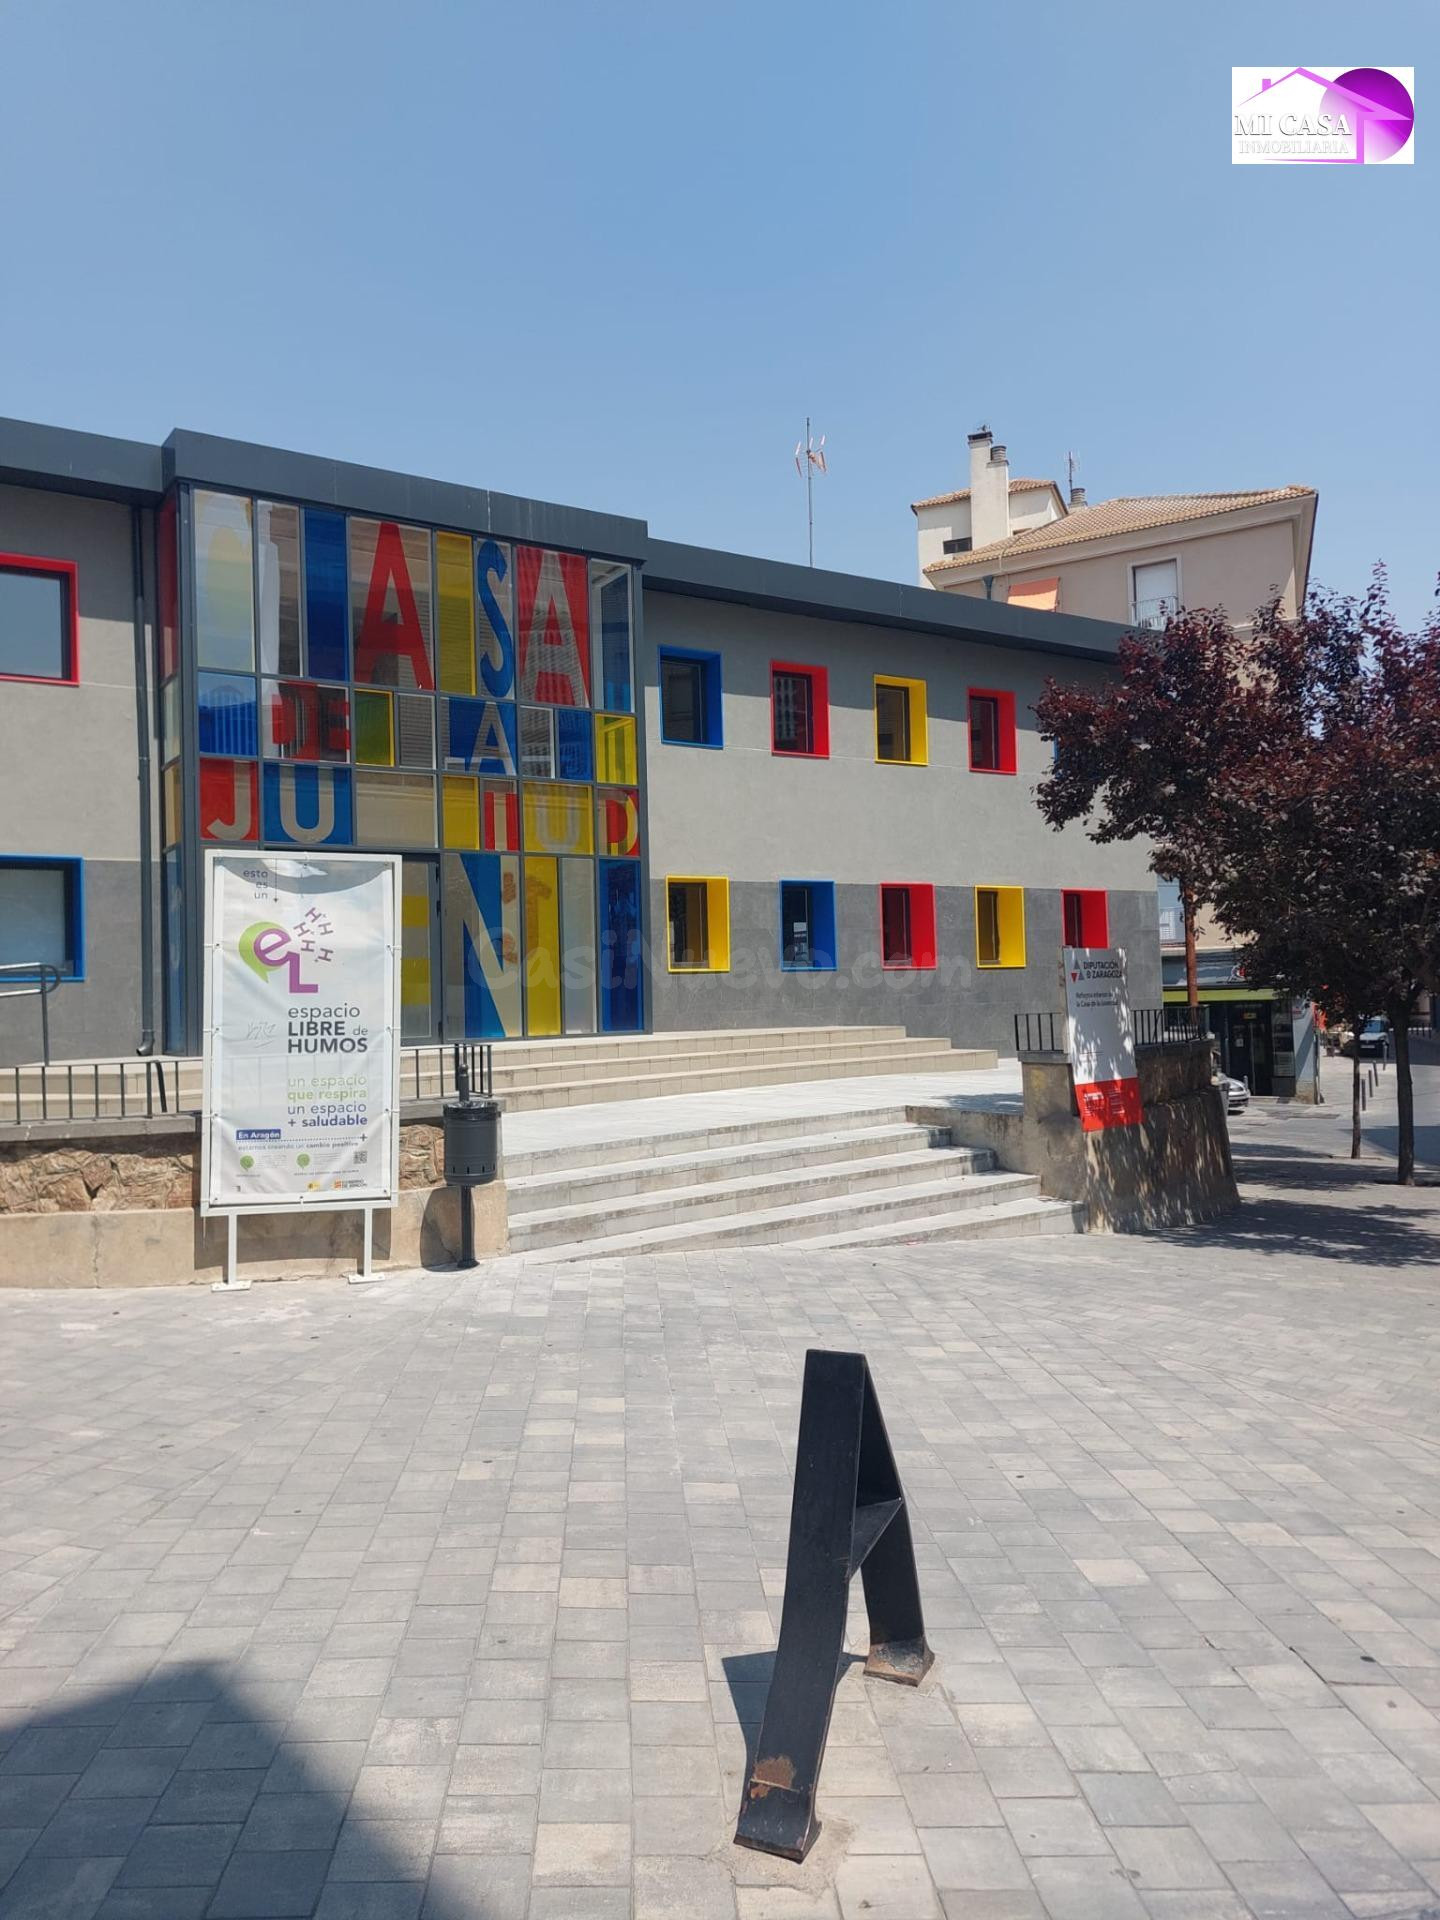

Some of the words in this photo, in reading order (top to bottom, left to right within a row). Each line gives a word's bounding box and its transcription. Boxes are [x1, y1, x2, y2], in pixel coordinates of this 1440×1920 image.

[243, 869, 268, 878] esto
[254, 891, 268, 899] un
[1092, 970, 1122, 979] ZARAGOZA
[288, 1002, 360, 1022] espacio
[288, 1021, 345, 1037] LIBRE
[353, 1024, 369, 1036] de
[288, 1038, 368, 1054] HUMOS
[288, 1078, 305, 1088] un
[311, 1074, 367, 1091] espacio
[288, 1091, 314, 1101] que
[318, 1088, 367, 1101] respira
[287, 1105, 305, 1115] un
[310, 1102, 367, 1118] espacio
[302, 1114, 368, 1128] saludable
[251, 1131, 280, 1140] Aragón
